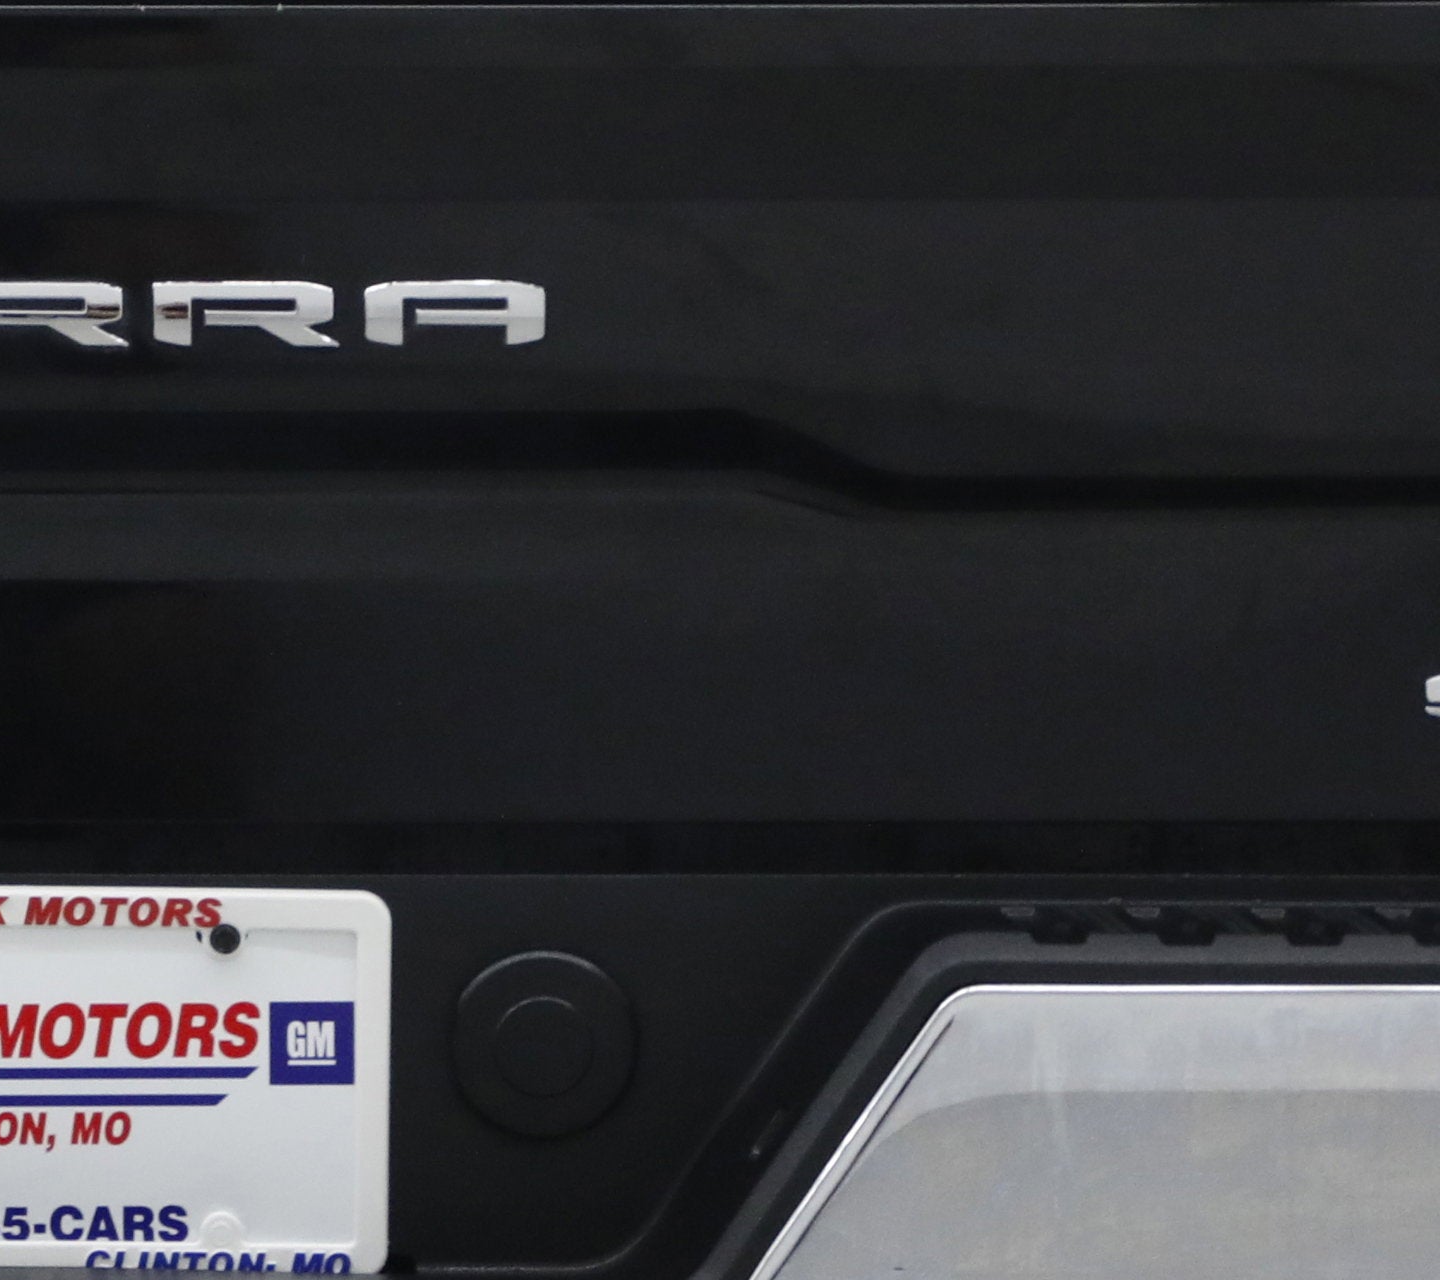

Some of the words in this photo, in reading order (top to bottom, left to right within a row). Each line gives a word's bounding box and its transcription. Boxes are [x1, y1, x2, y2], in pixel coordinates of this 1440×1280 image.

[24, 896, 223, 929] MOTORS
[286, 1020, 336, 1059] GM
[70, 1111, 132, 1147] MO
[290, 1252, 352, 1275] MO
